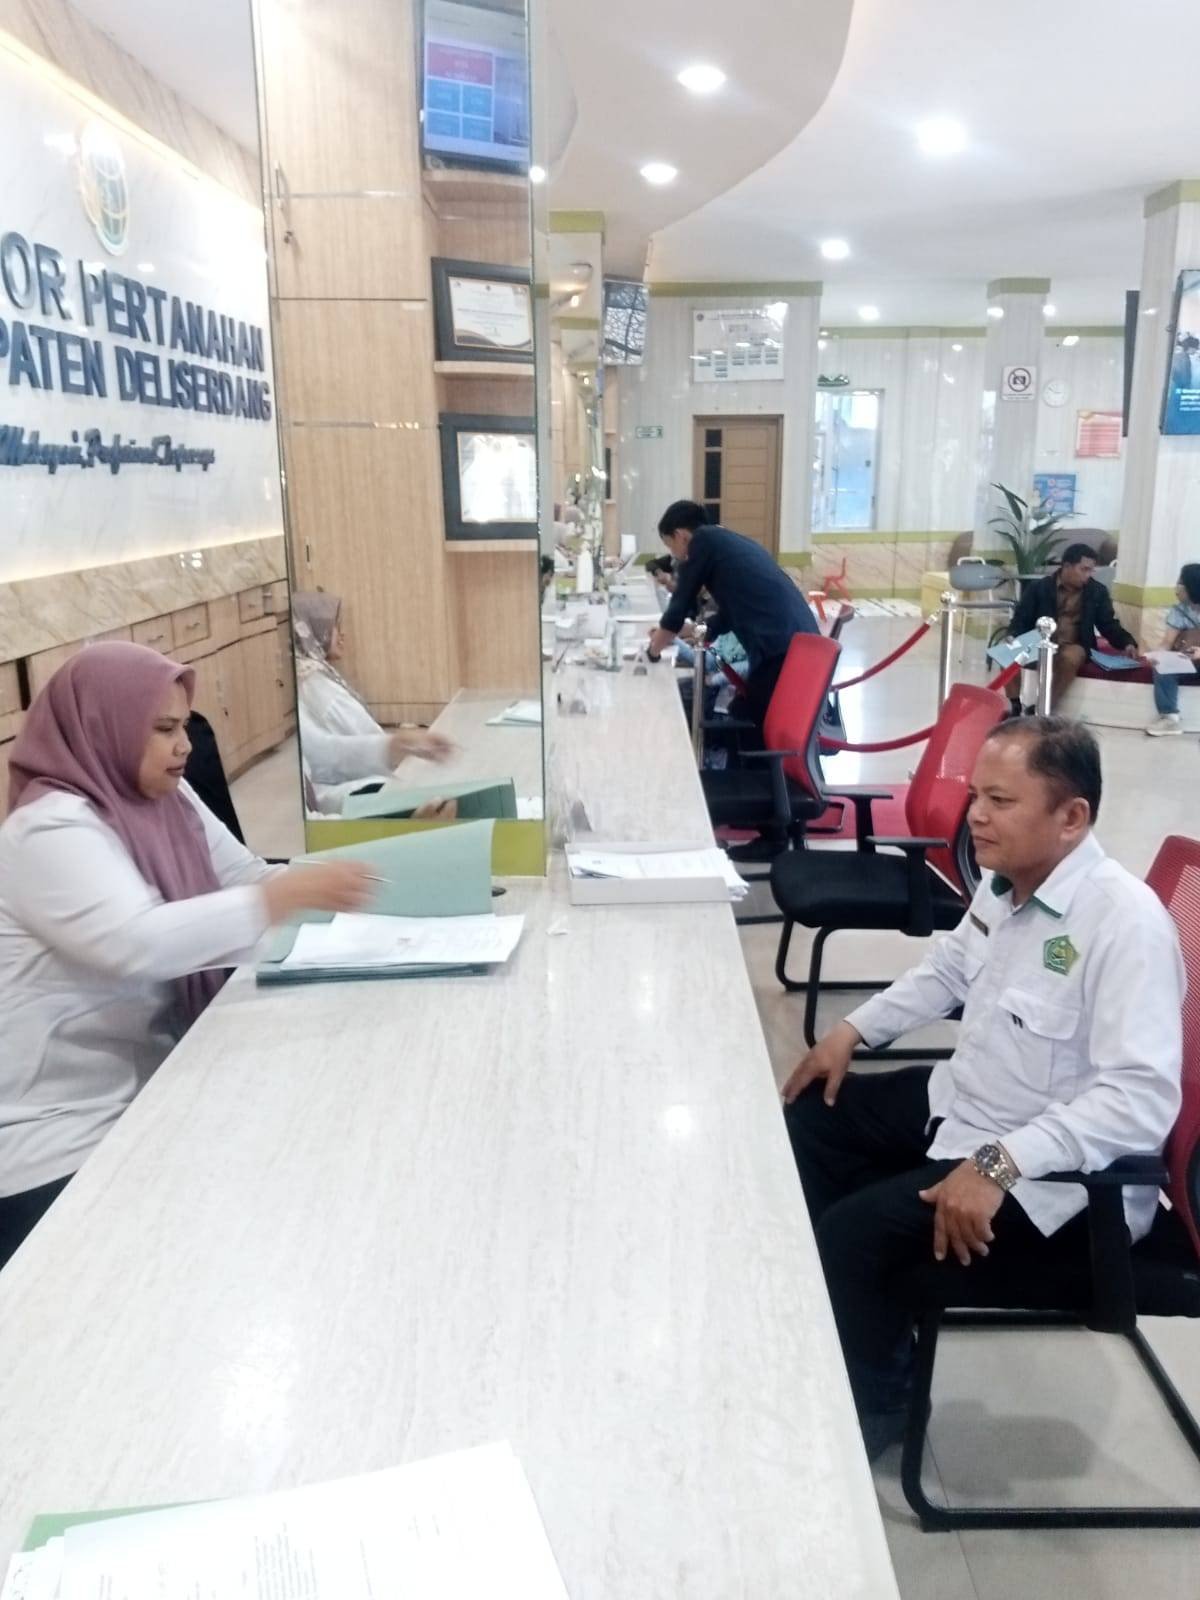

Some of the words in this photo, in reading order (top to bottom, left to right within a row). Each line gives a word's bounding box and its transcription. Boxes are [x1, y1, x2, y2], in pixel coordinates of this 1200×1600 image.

[0, 231, 72, 320] OR
[78, 259, 264, 372] PERTANAHAN
[114, 345, 272, 421] DELISERDANG
